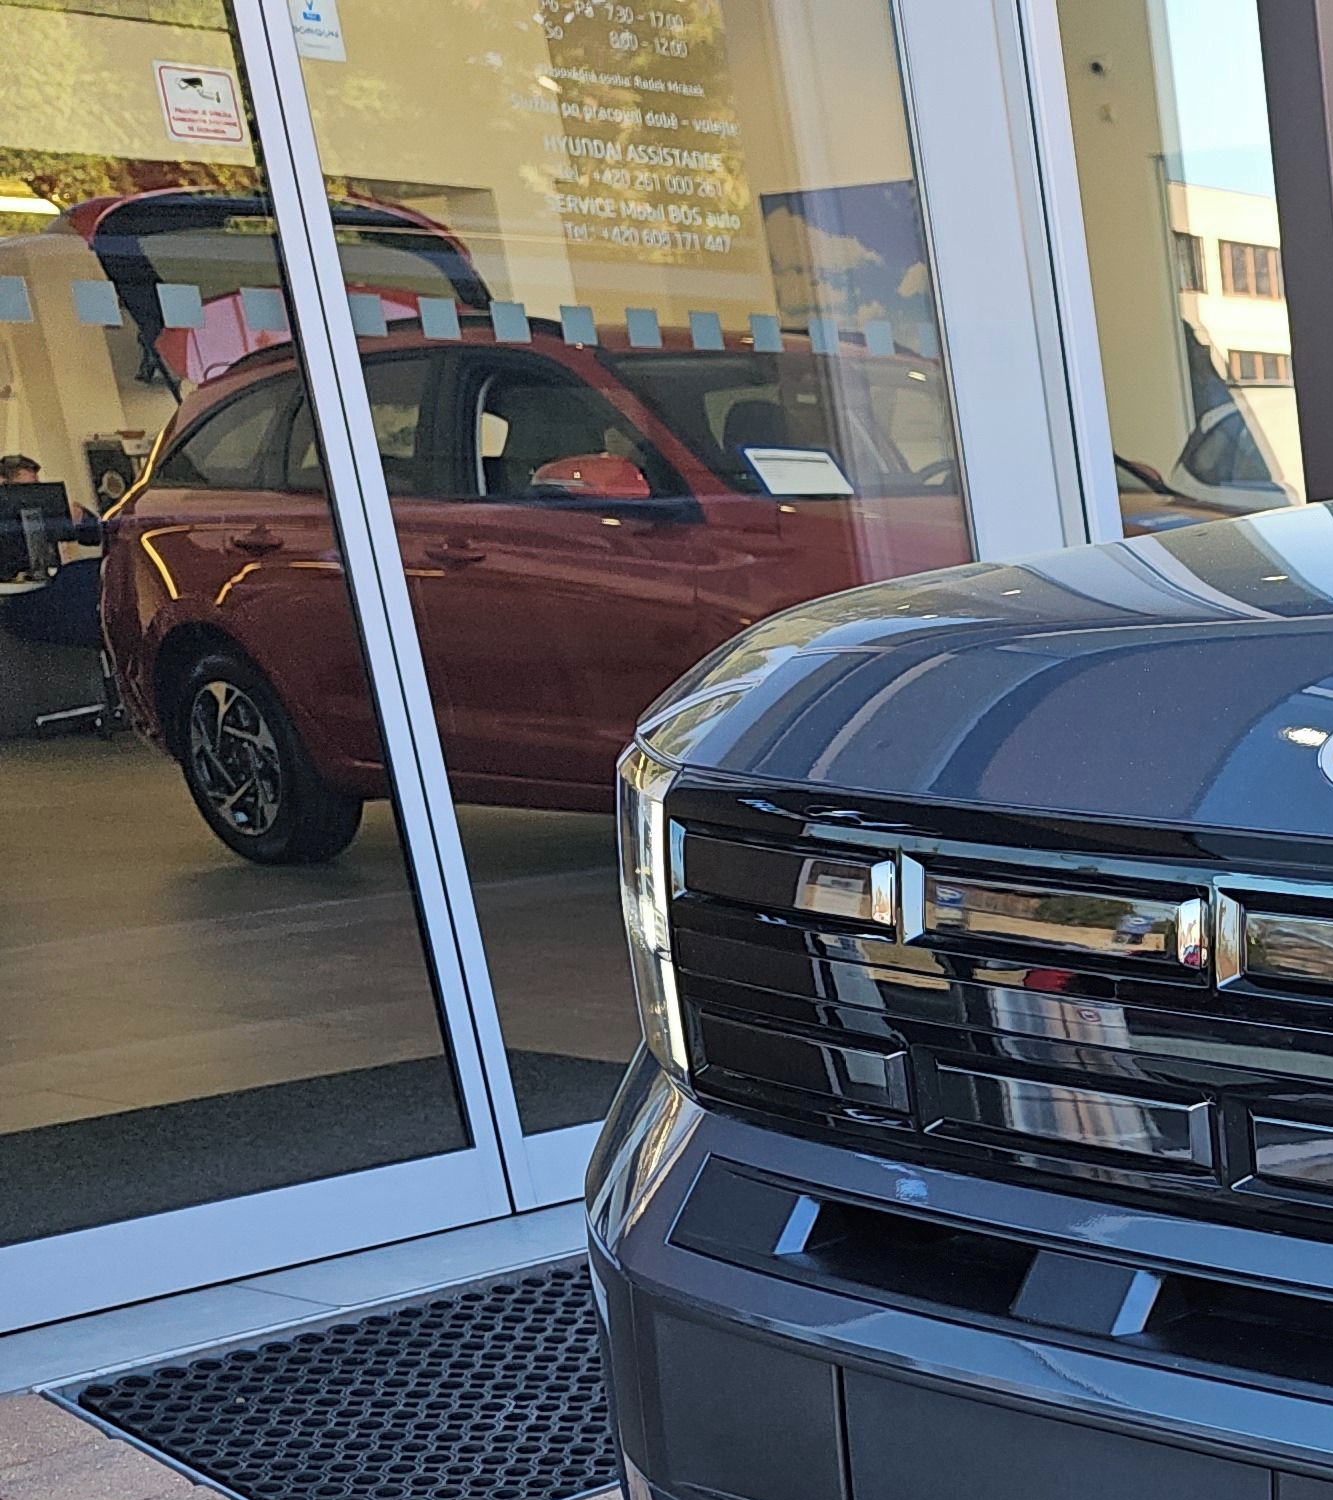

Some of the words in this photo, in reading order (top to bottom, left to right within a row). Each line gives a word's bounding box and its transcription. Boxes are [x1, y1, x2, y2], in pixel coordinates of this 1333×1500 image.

[544, 136, 622, 161] HYUNDAI
[627, 144, 722, 171] ASSISTANCE
[668, 203, 703, 226] BOS
